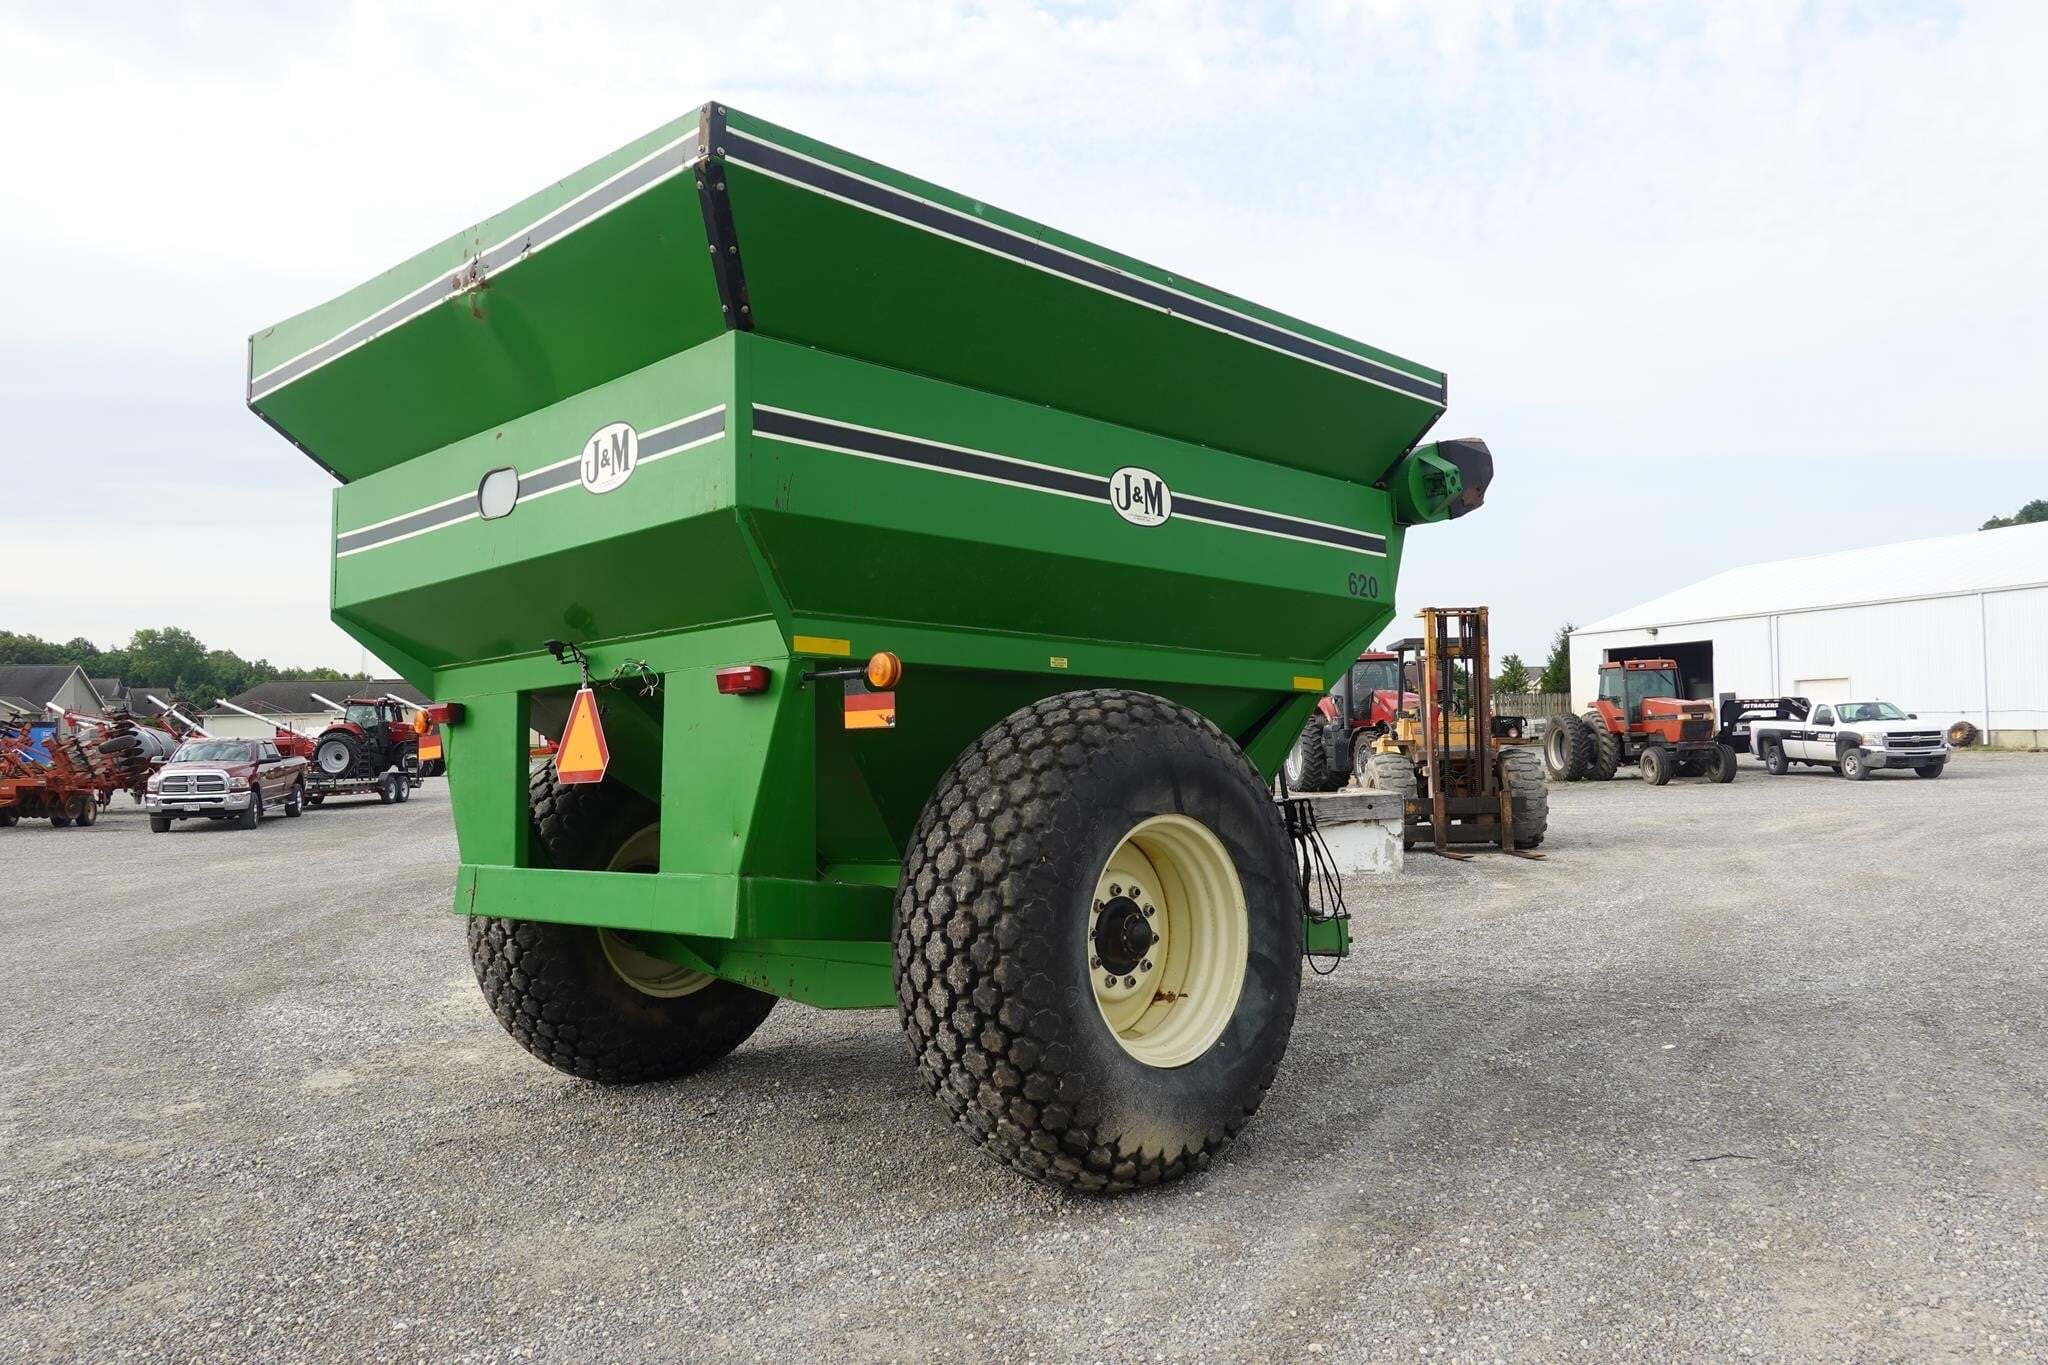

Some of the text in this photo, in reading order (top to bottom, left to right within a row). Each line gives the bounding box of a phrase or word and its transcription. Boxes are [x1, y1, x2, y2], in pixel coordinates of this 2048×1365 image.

[585, 428, 630, 483] J&M
[1115, 473, 1164, 517] J&M
[1348, 572, 1378, 599] 620
